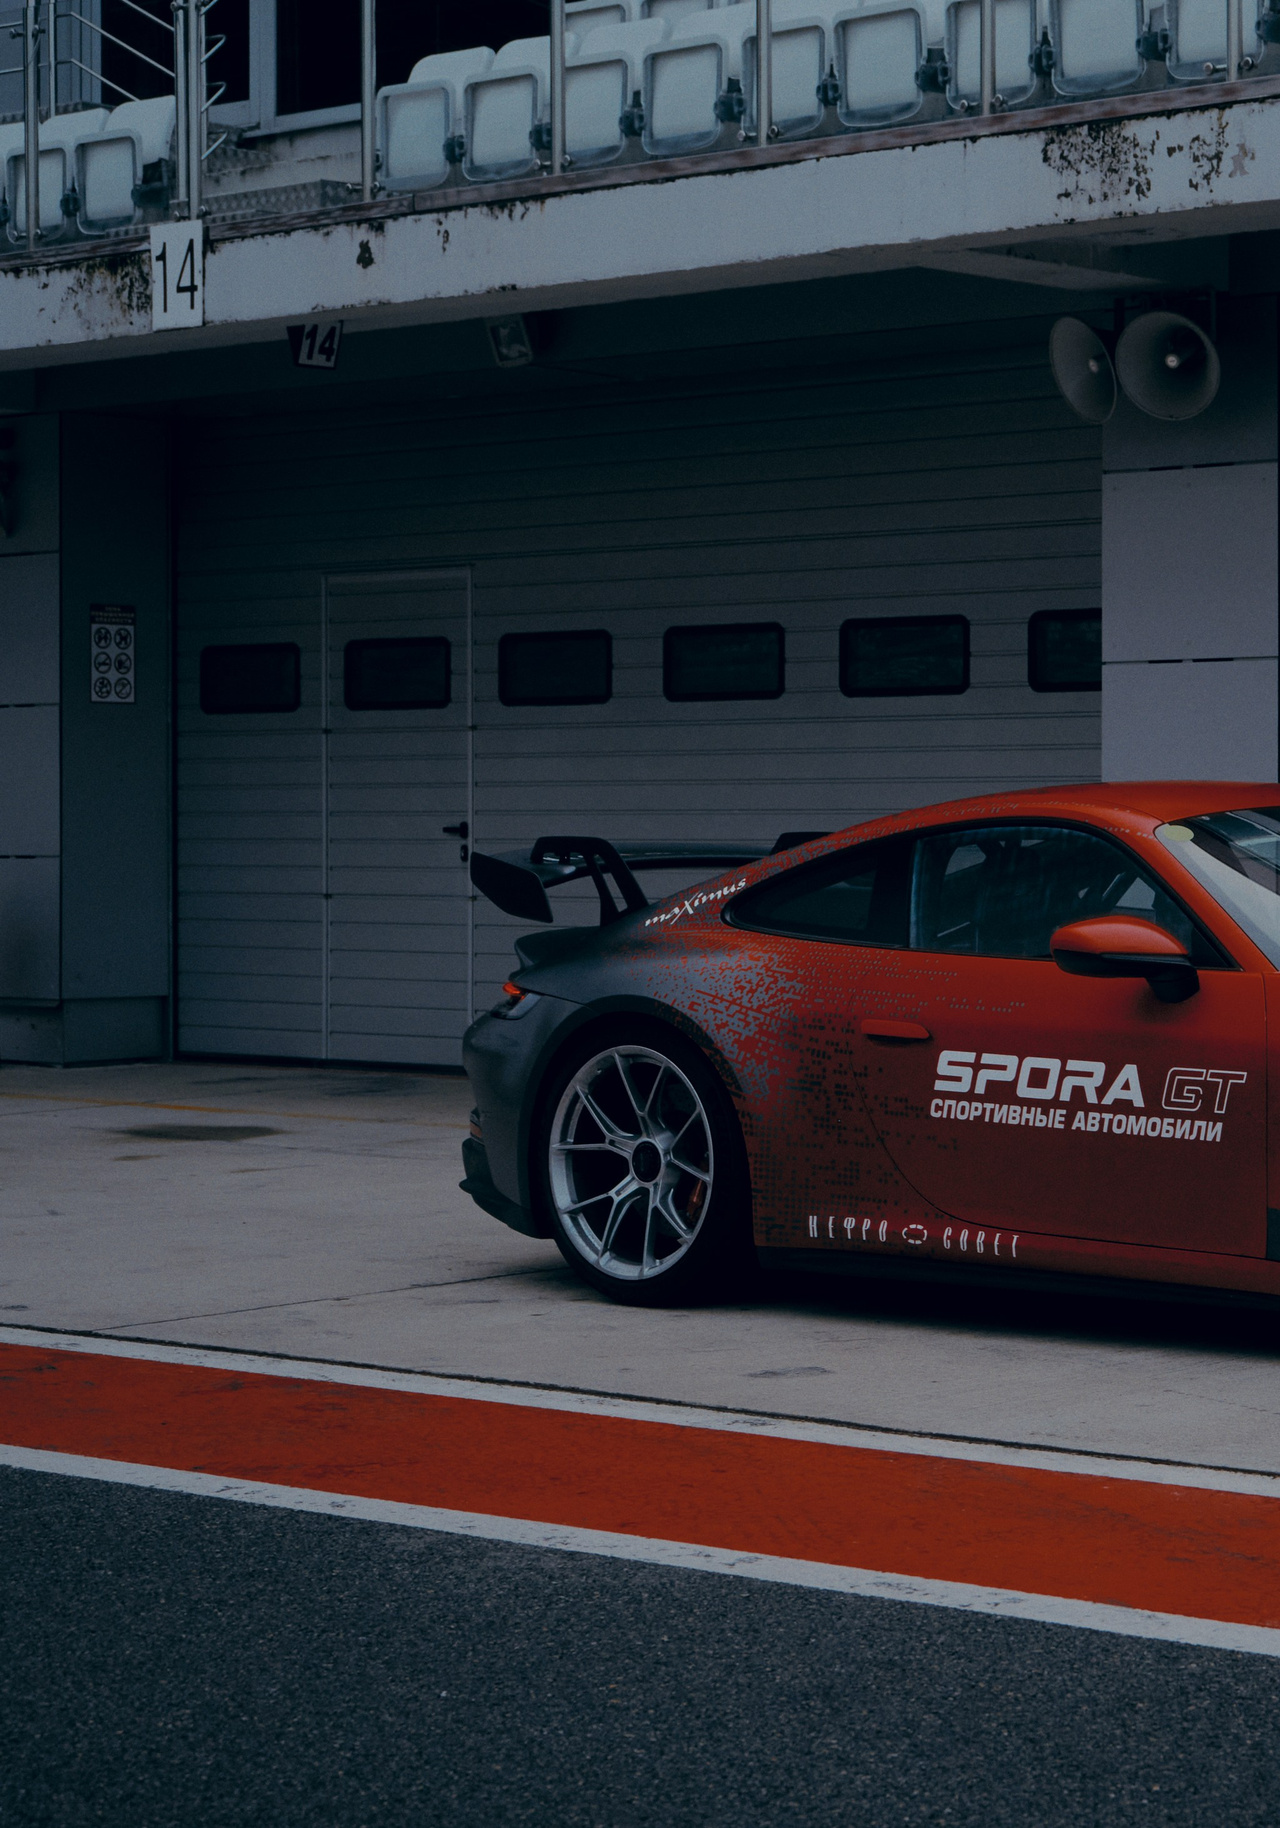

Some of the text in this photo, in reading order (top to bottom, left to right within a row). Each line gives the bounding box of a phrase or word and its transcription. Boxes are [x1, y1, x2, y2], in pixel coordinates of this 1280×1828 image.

[155, 238, 198, 313] 14
[305, 324, 337, 362] 14
[933, 1049, 1248, 1114] SPORA GT
[930, 1098, 1223, 1143] СПОРТИВНЫЕ АВТОМОБИЛИ
[808, 1215, 1020, 1258] НЕФРО СОВЕТ
